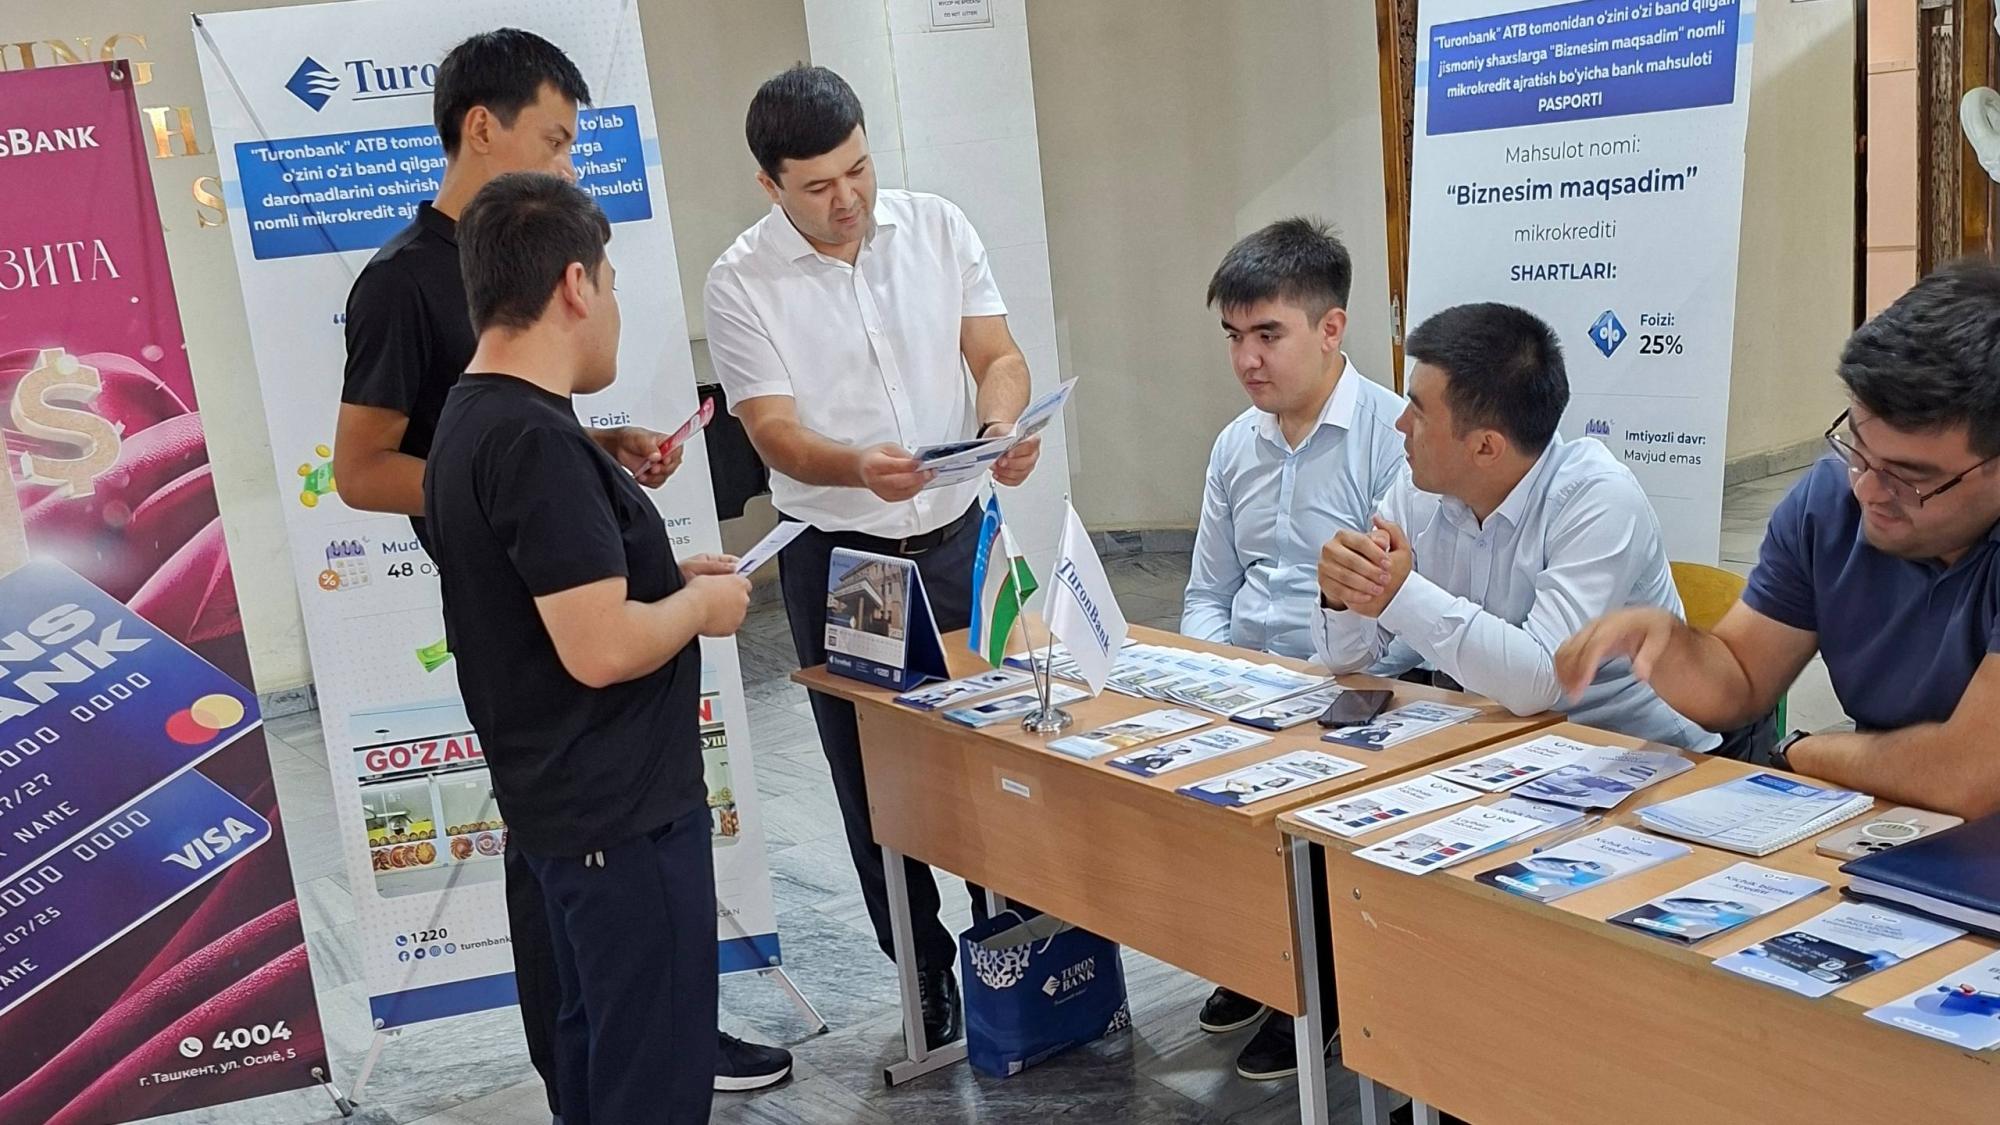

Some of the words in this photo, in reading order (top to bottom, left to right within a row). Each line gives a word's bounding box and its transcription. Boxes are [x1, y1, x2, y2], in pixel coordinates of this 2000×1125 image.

[1433, 27, 1501, 49] "Turonbank"
[1503, 23, 1527, 39] ATB
[1529, 13, 1594, 36] tomonidan
[1597, 7, 1628, 25] o'zini
[1631, 3, 1652, 19] o'zi
[1655, 0, 1689, 16] band
[1438, 57, 1484, 77] jismoniy
[1486, 50, 1547, 68] shaxslarga
[1550, 39, 1609, 58] "Biznesim
[1611, 26, 1684, 50] maqsadim"
[1687, 20, 1725, 39] nomli
[1447, 78, 1510, 97] mikrokredit
[1513, 71, 1557, 92] ajratish
[1559, 68, 1609, 84] bo'yicha
[1612, 60, 1643, 77] bank
[1646, 50, 1712, 73] mahsuloti
[1538, 92, 1602, 112] PASPORTI
[251, 140, 350, 162] "Turonbank"
[355, 136, 387, 153] ATB
[580, 114, 624, 131] to'lab
[1506, 141, 1583, 164] Mahsulot
[1589, 135, 1640, 157] nomi:
[262, 184, 374, 207] daromadlarini
[378, 178, 440, 197] oshirish
[574, 158, 627, 180] yihasi"
[282, 169, 323, 183] o'zini
[327, 164, 353, 179] o'zi
[356, 159, 397, 176] band
[400, 156, 447, 174] qilgan
[1447, 178, 1552, 206] “Biznesim
[1560, 166, 1698, 201] maqsadim”
[254, 216, 299, 231] nomli
[302, 205, 395, 226] mikrokredit
[1514, 220, 1616, 242] mikrokrediti
[1510, 262, 1617, 281] SHARTLARI:
[1640, 313, 1675, 326] Foizi:
[1639, 335, 1683, 355] 25%
[590, 412, 631, 427] Foizi:
[1625, 430, 1676, 444] Imtiyozli
[1677, 433, 1706, 445] davr:
[1624, 450, 1666, 464] Mavjud
[1669, 453, 1701, 465] emas
[387, 562, 414, 578] 48
[1057, 557, 1111, 653] TuronBank
[0, 726, 60, 774] 000
[70, 672, 151, 722] 0000
[13, 801, 80, 843] NAME
[162, 817, 256, 870] VISA
[0, 865, 63, 918] 000
[72, 810, 151, 861] 0000
[4, 906, 61, 945] 07/25
[411, 928, 448, 943] 1220
[0, 958, 39, 991] AME
[1061, 956, 1095, 979] TURON
[1062, 969, 1096, 992] BANK
[212, 1020, 292, 1051] 4004
[139, 1075, 151, 1087] г.
[152, 1064, 219, 1084] Ташкент,
[220, 1060, 241, 1074] ул.
[243, 1050, 285, 1067] Осиё,
[286, 1048, 297, 1059] 5
